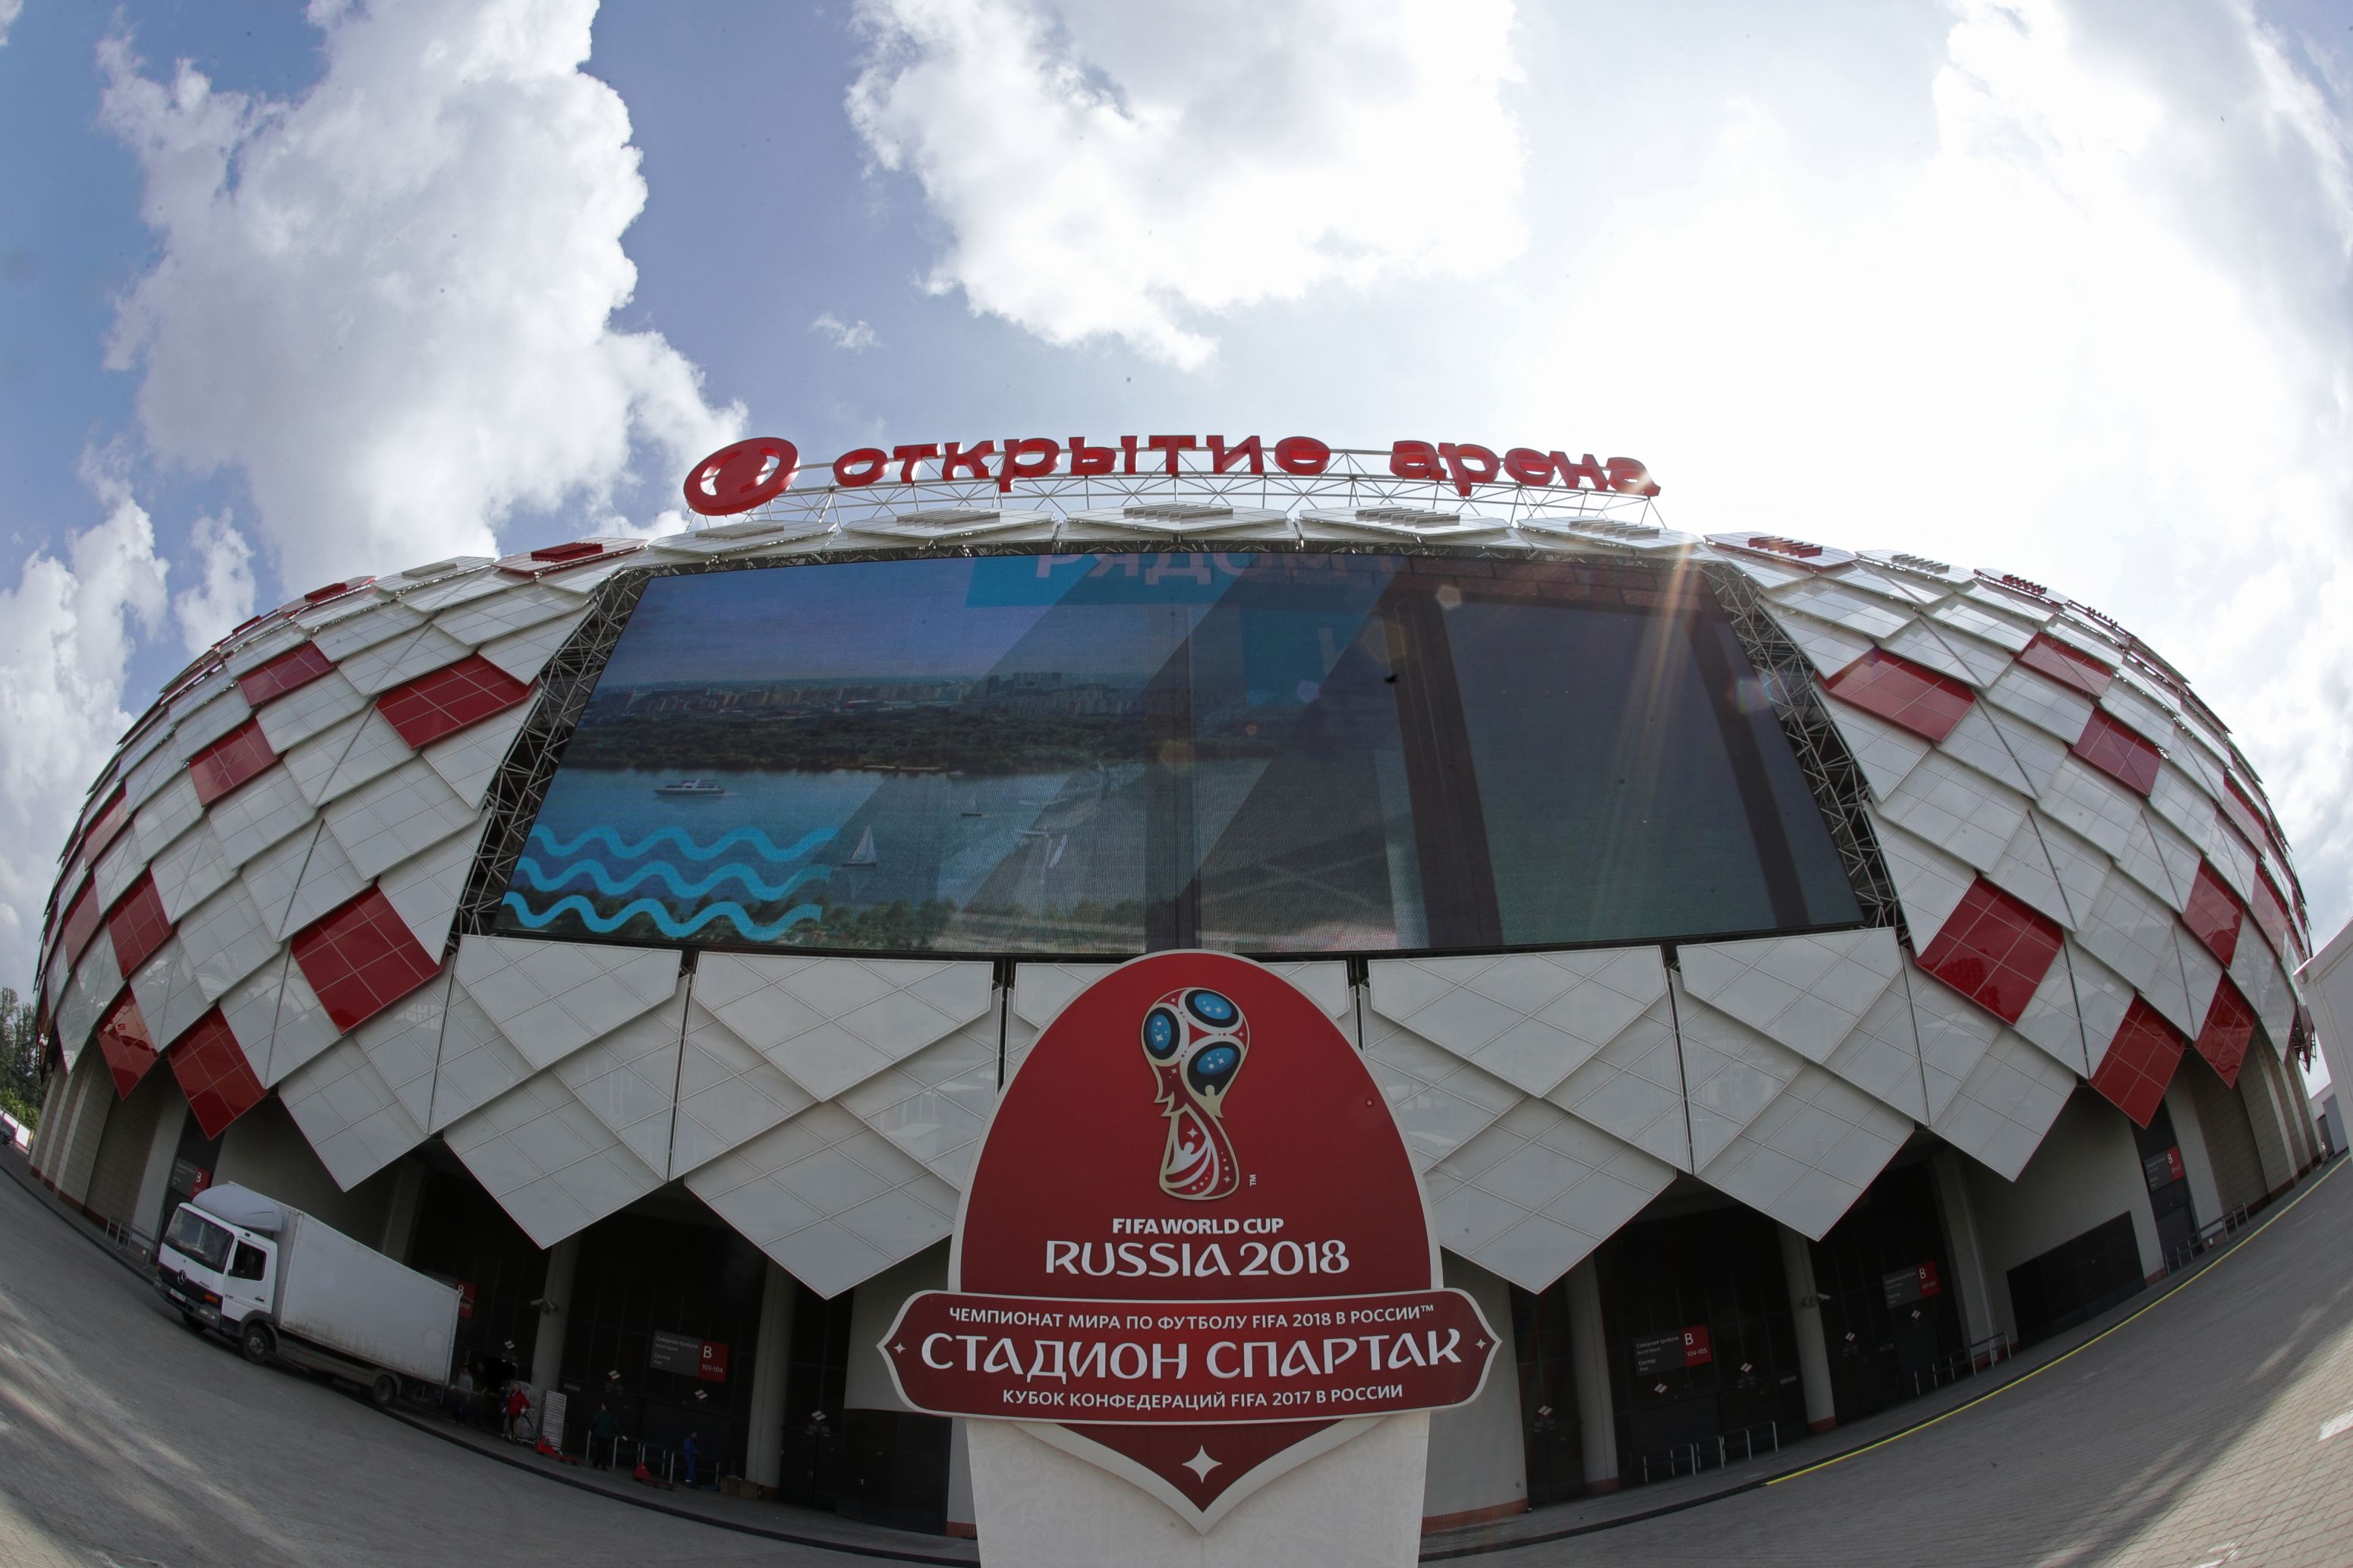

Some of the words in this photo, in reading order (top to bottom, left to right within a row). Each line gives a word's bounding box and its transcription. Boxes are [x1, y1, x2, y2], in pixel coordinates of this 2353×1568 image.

[833, 436, 1331, 493] открытие
[1390, 440, 1661, 496] арена
[1112, 1217, 1160, 1234] FIFA
[1161, 1218, 1239, 1235] WORLD
[1243, 1217, 1284, 1235] CUP
[1045, 1240, 1232, 1277] RUSSIA
[1238, 1239, 1350, 1276] 2018
[950, 1307, 1064, 1327] ЧЕМПИОНАТ
[1068, 1314, 1121, 1329] МИРА
[1126, 1315, 1153, 1330] ПО
[1158, 1315, 1248, 1330] ФУТБОЛУ
[1252, 1315, 1288, 1329] FIFA
[1293, 1312, 1331, 1327] 2018
[1336, 1311, 1346, 1325] В
[921, 1332, 1187, 1385] СТАДИОН
[1206, 1328, 1462, 1379] СПАРТАК
[1687, 1347, 1707, 1357] 104-105
[701, 1364, 723, 1373] 103-104
[1003, 1389, 1065, 1406] КУБОК
[1069, 1391, 1226, 1411] КОНФЕДЕРАЦИЙ
[1231, 1393, 1268, 1407] FIFA
[1272, 1390, 1312, 1406] 2017
[1315, 1390, 1327, 1403] В
[1331, 1384, 1403, 1403] РОССИИ
